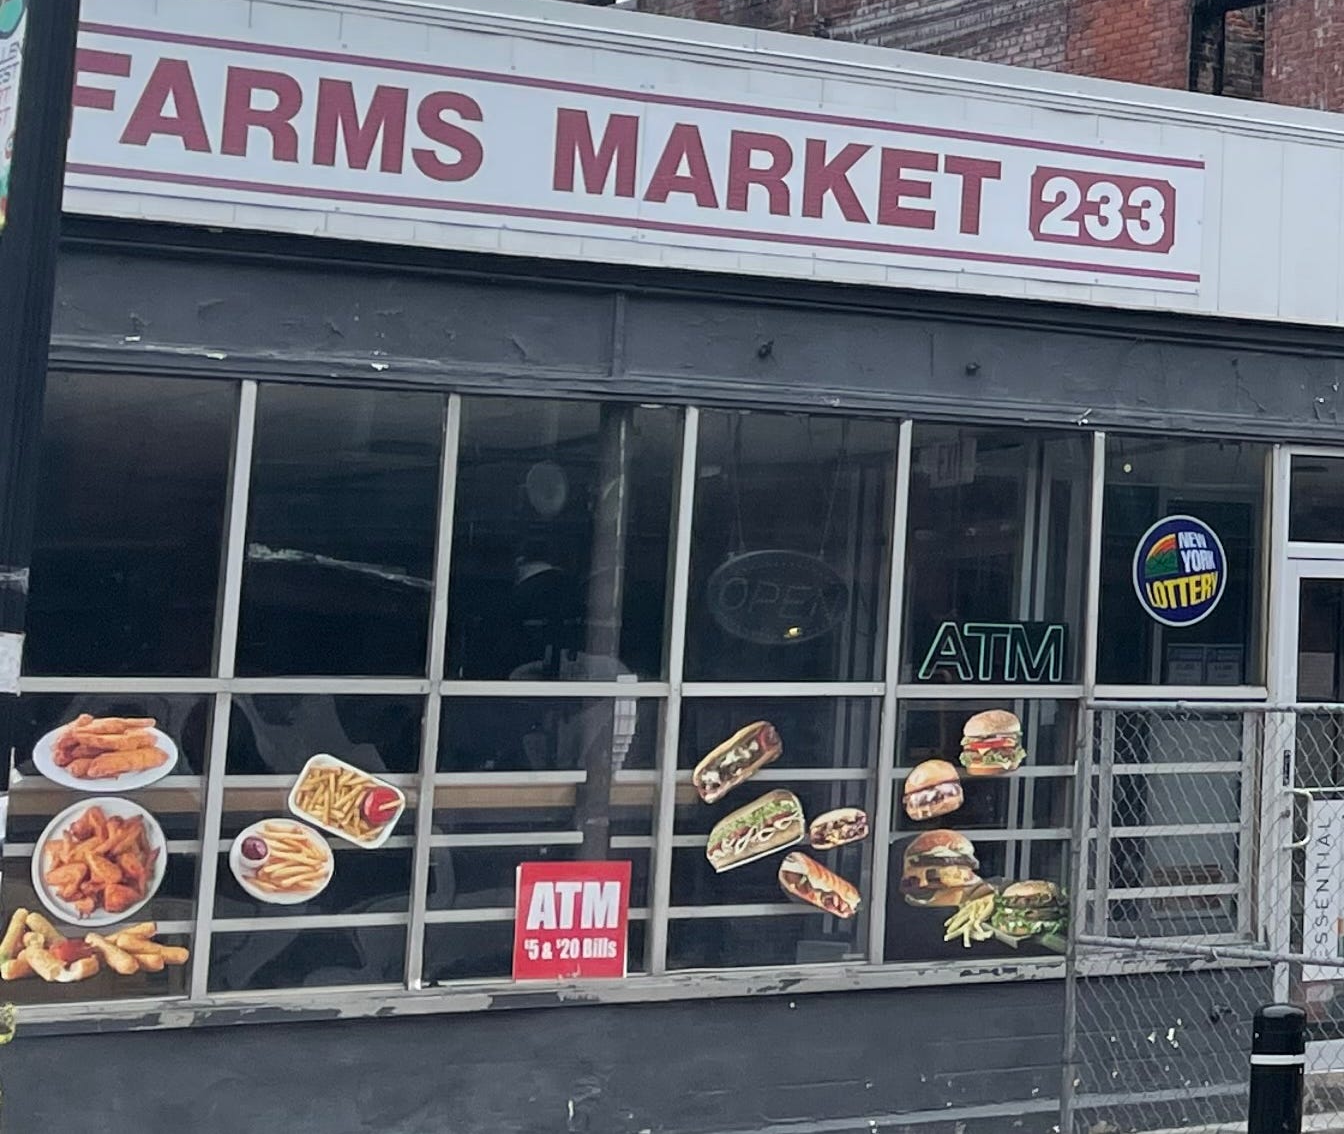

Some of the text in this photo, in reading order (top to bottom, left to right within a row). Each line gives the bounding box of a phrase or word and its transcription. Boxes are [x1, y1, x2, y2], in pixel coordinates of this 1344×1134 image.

[68, 49, 1166, 246] FARMS MARKET 233
[1178, 531, 1208, 550] NEW
[1180, 550, 1217, 573] YORK
[1145, 571, 1219, 609] LOTTERY
[918, 621, 1066, 681] ATM
[526, 881, 621, 930] ATM
[524, 937, 617, 960] $5 & $20 Bills
